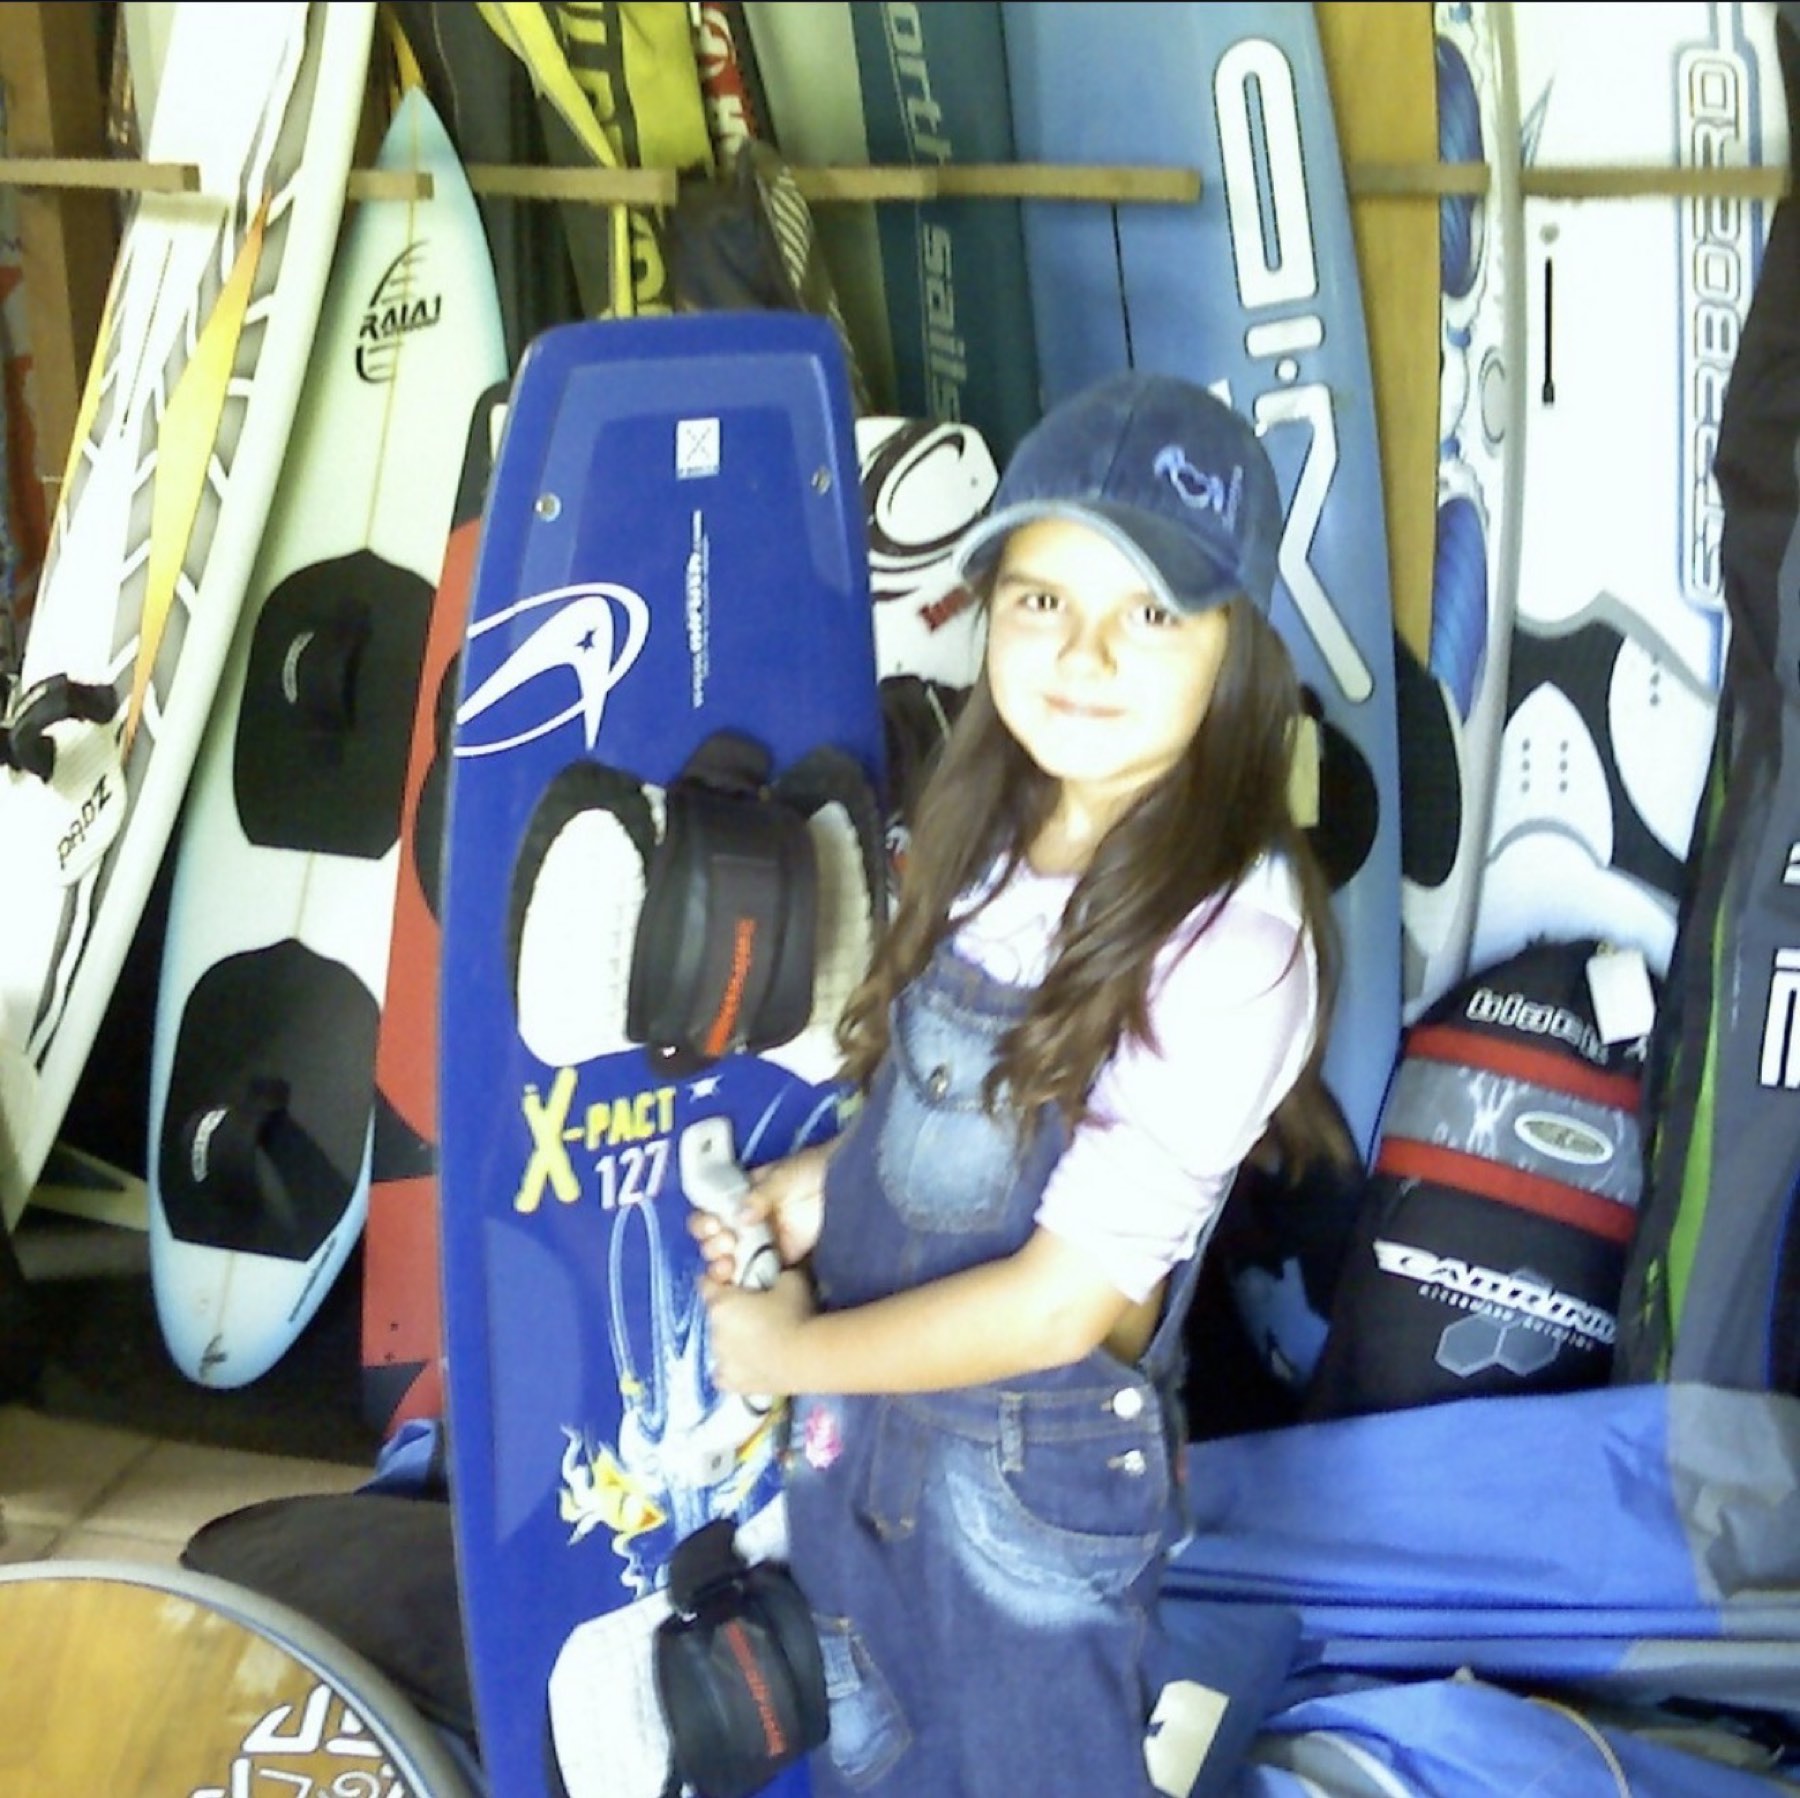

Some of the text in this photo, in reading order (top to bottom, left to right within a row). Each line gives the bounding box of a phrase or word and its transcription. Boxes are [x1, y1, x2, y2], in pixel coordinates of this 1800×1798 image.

[921, 222, 968, 421] sails
[513, 1066, 677, 1213] X-PACT
[594, 1138, 670, 1210] 127
